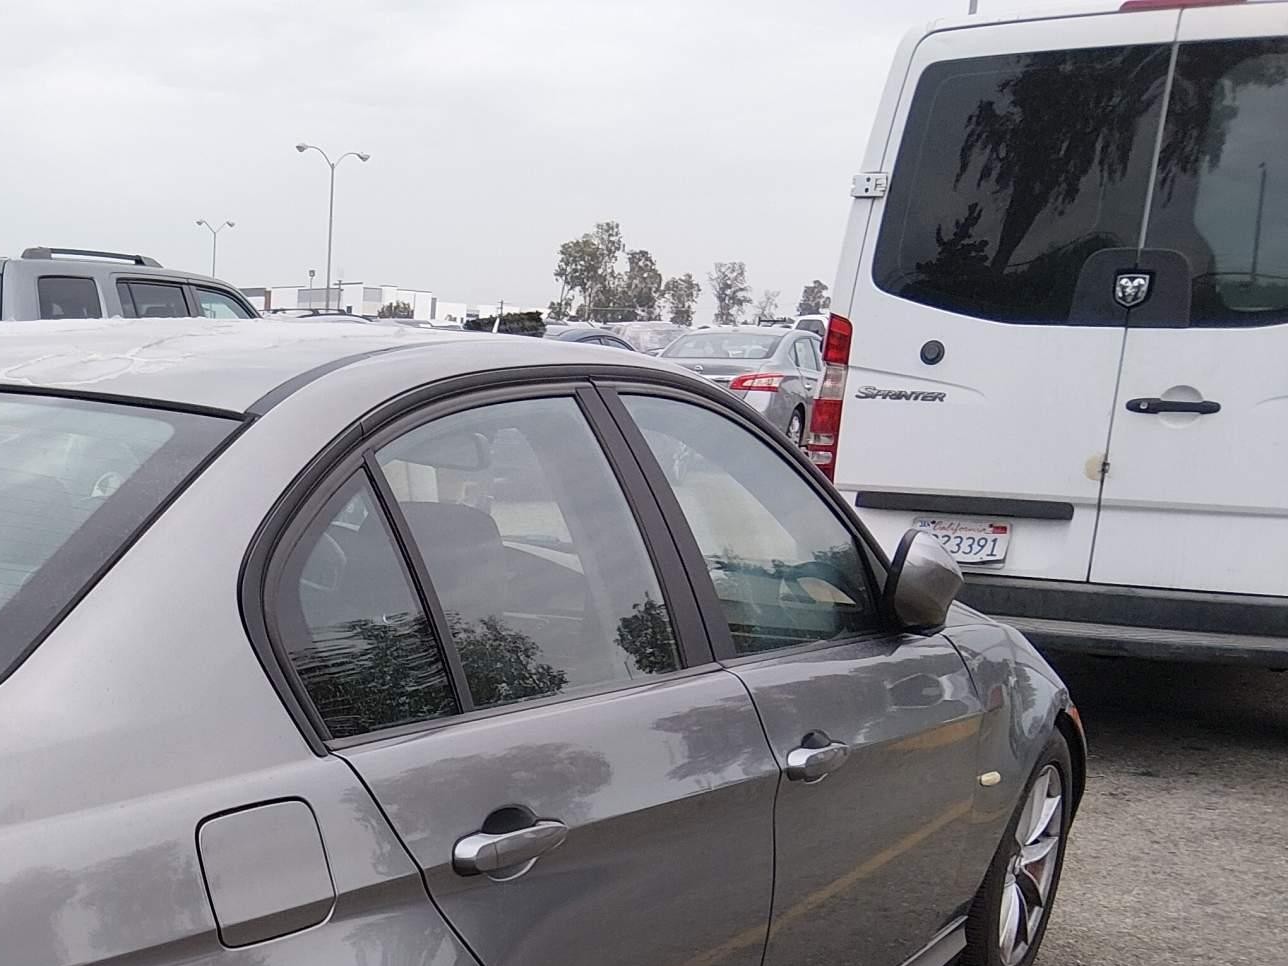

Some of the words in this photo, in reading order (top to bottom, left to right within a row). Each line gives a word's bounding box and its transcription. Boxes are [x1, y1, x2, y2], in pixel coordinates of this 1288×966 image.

[855, 386, 946, 402] SPRINTER
[932, 520, 986, 535] California
[932, 533, 998, 557] 23391
